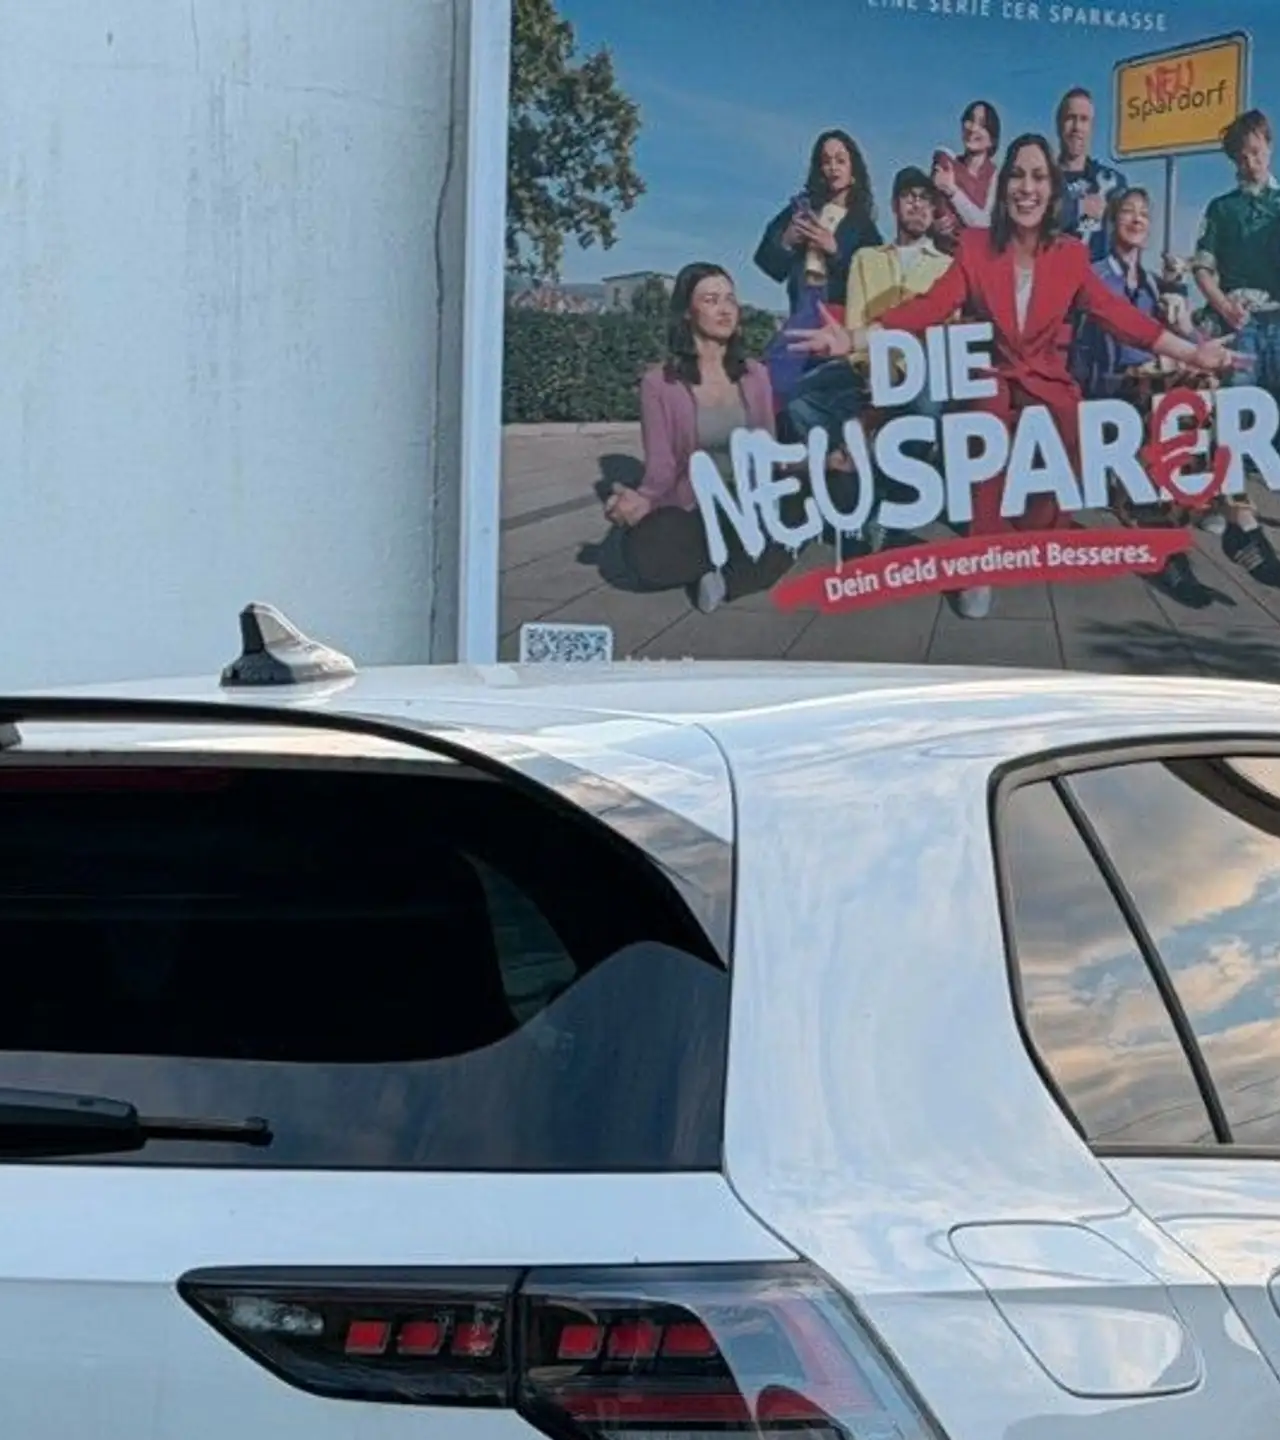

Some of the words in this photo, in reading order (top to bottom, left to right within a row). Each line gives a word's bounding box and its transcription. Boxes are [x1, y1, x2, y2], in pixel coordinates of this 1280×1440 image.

[1048, 5, 1168, 32] SPARKASSE
[1126, 79, 1227, 122] Spardorf
[867, 321, 999, 408] DIE
[824, 571, 879, 602] Dein
[883, 556, 938, 588] Geld
[941, 544, 1042, 577] verdient
[1046, 542, 1158, 568] Besseres.
